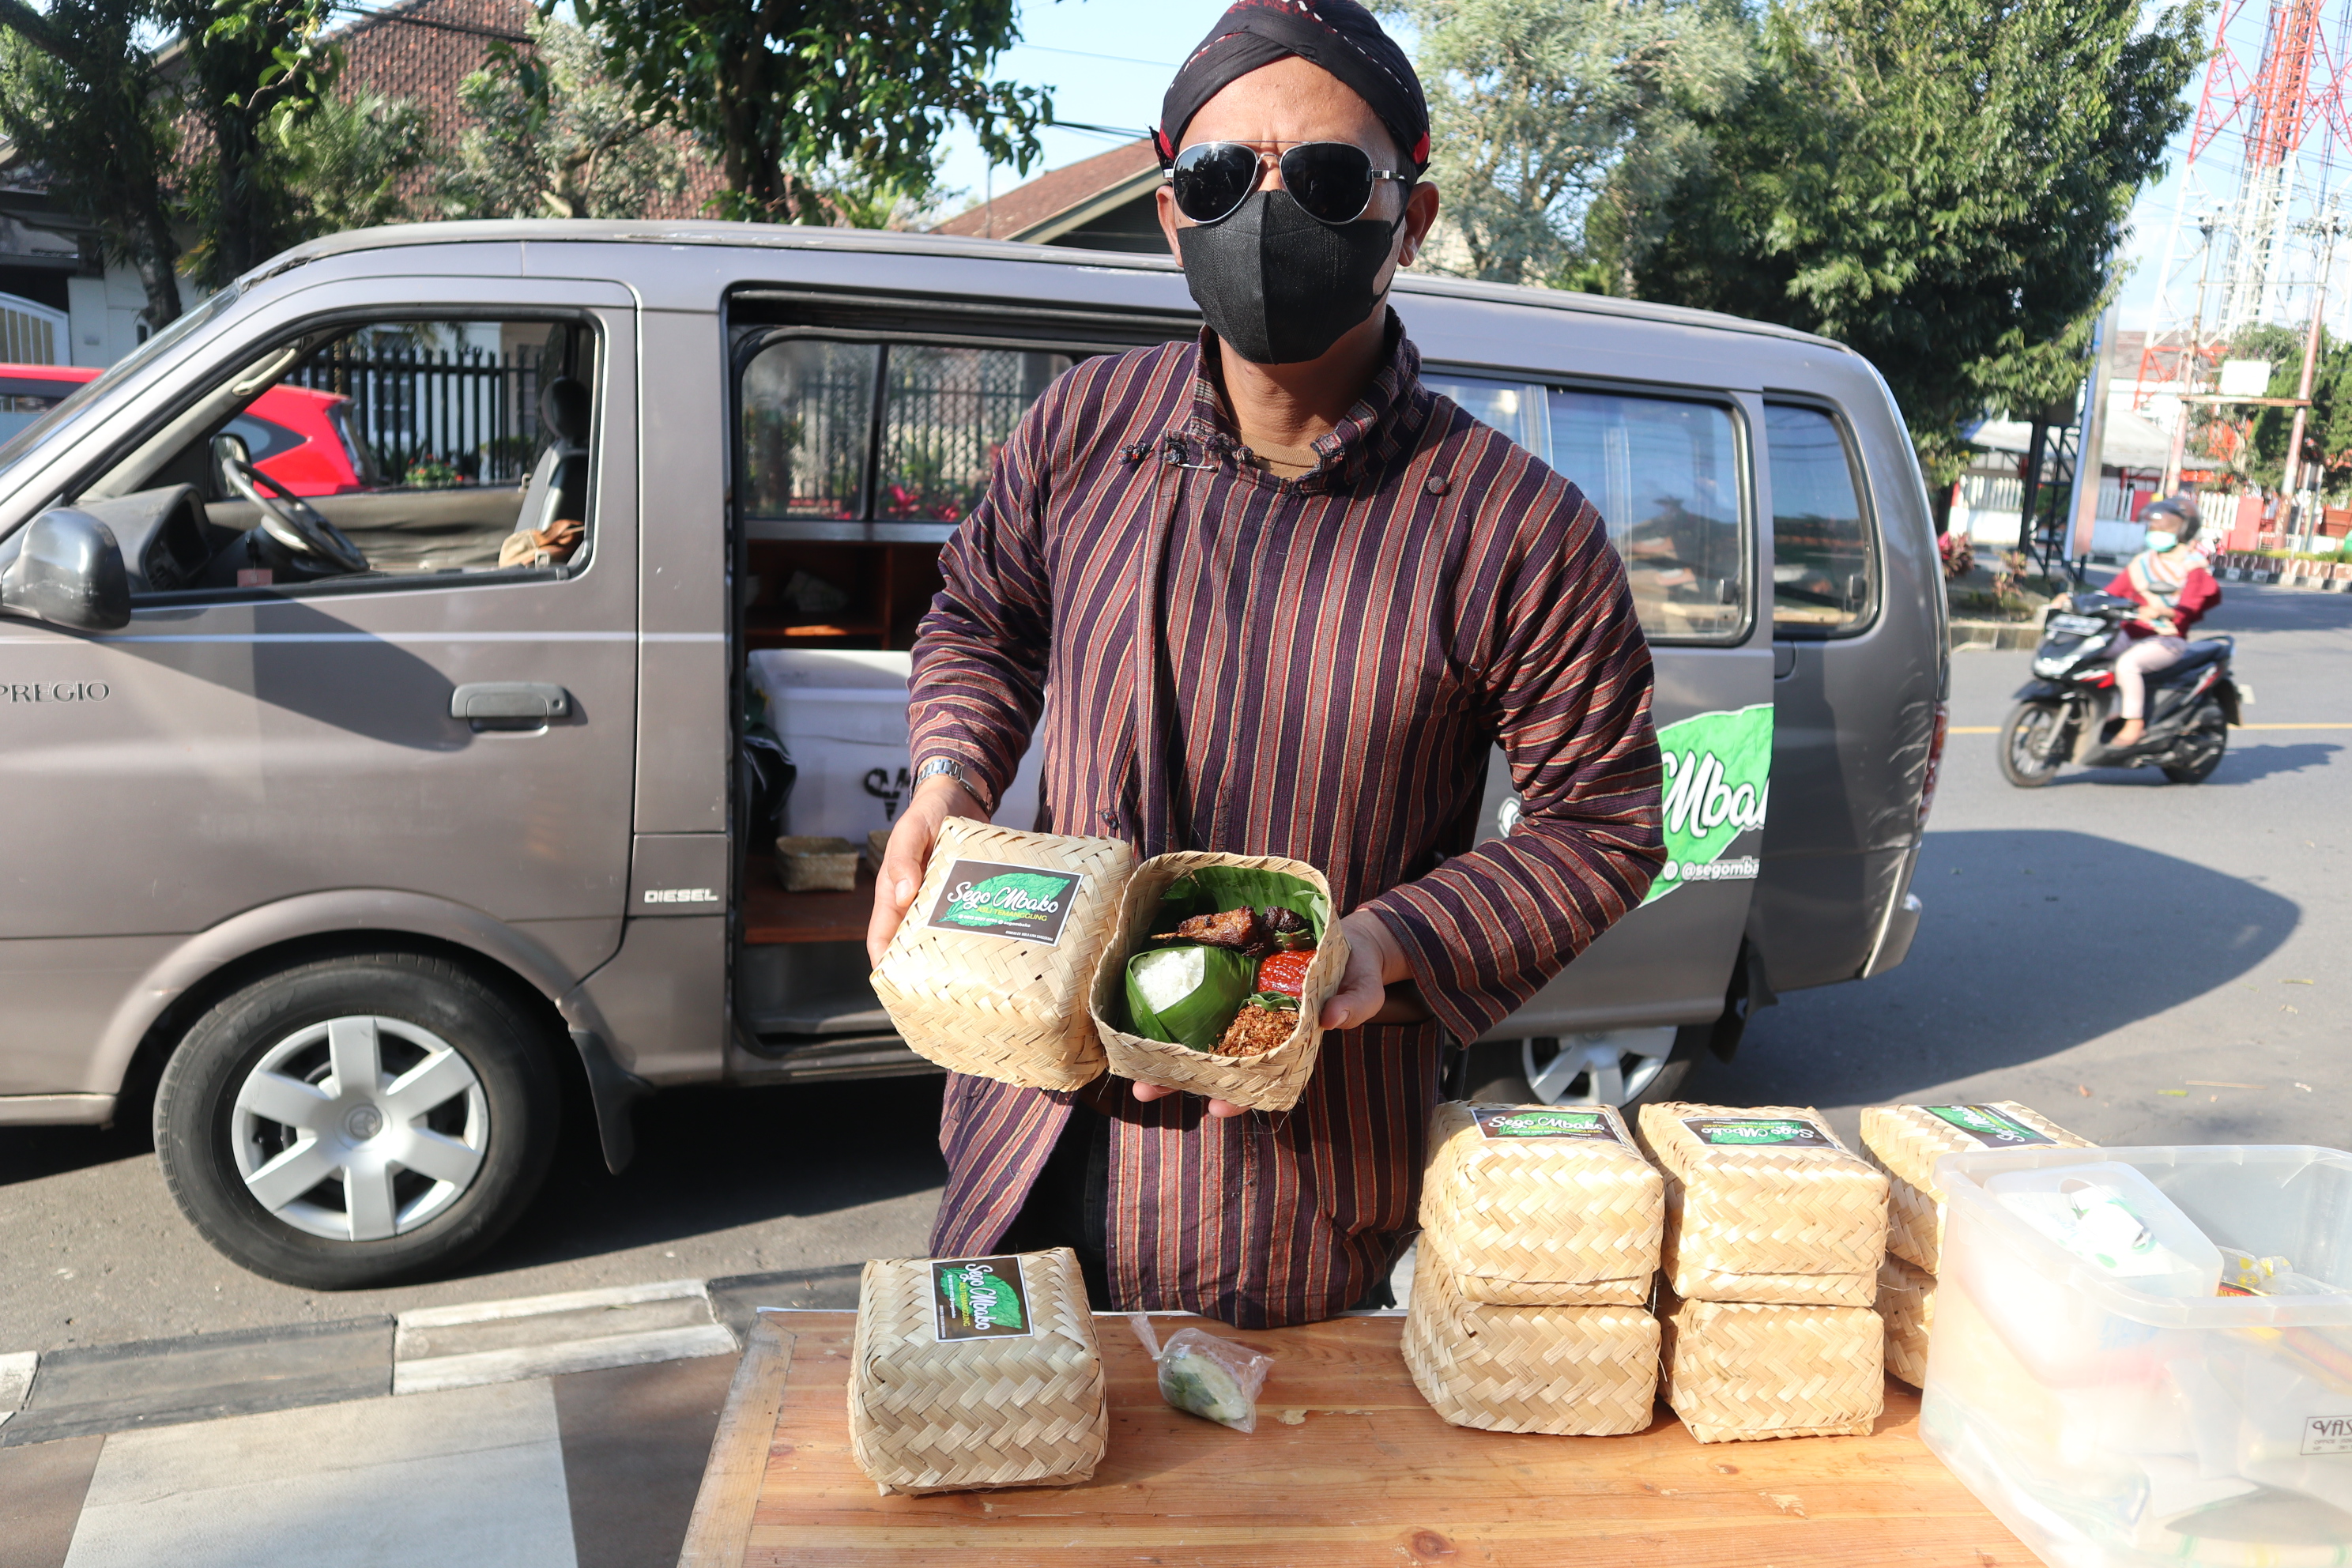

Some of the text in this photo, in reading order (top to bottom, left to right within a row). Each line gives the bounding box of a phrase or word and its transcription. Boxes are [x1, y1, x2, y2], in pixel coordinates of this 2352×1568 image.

[644, 888, 718, 903] DIESEL
[947, 881, 1059, 914] Sego Mbako
[976, 906, 1048, 922] ASLI TEMANGGUNG
[1488, 1115, 1606, 1131] Sego Mbako
[1701, 1125, 1815, 1139] Sego Mbako
[959, 1263, 998, 1330] Sego Mbako
